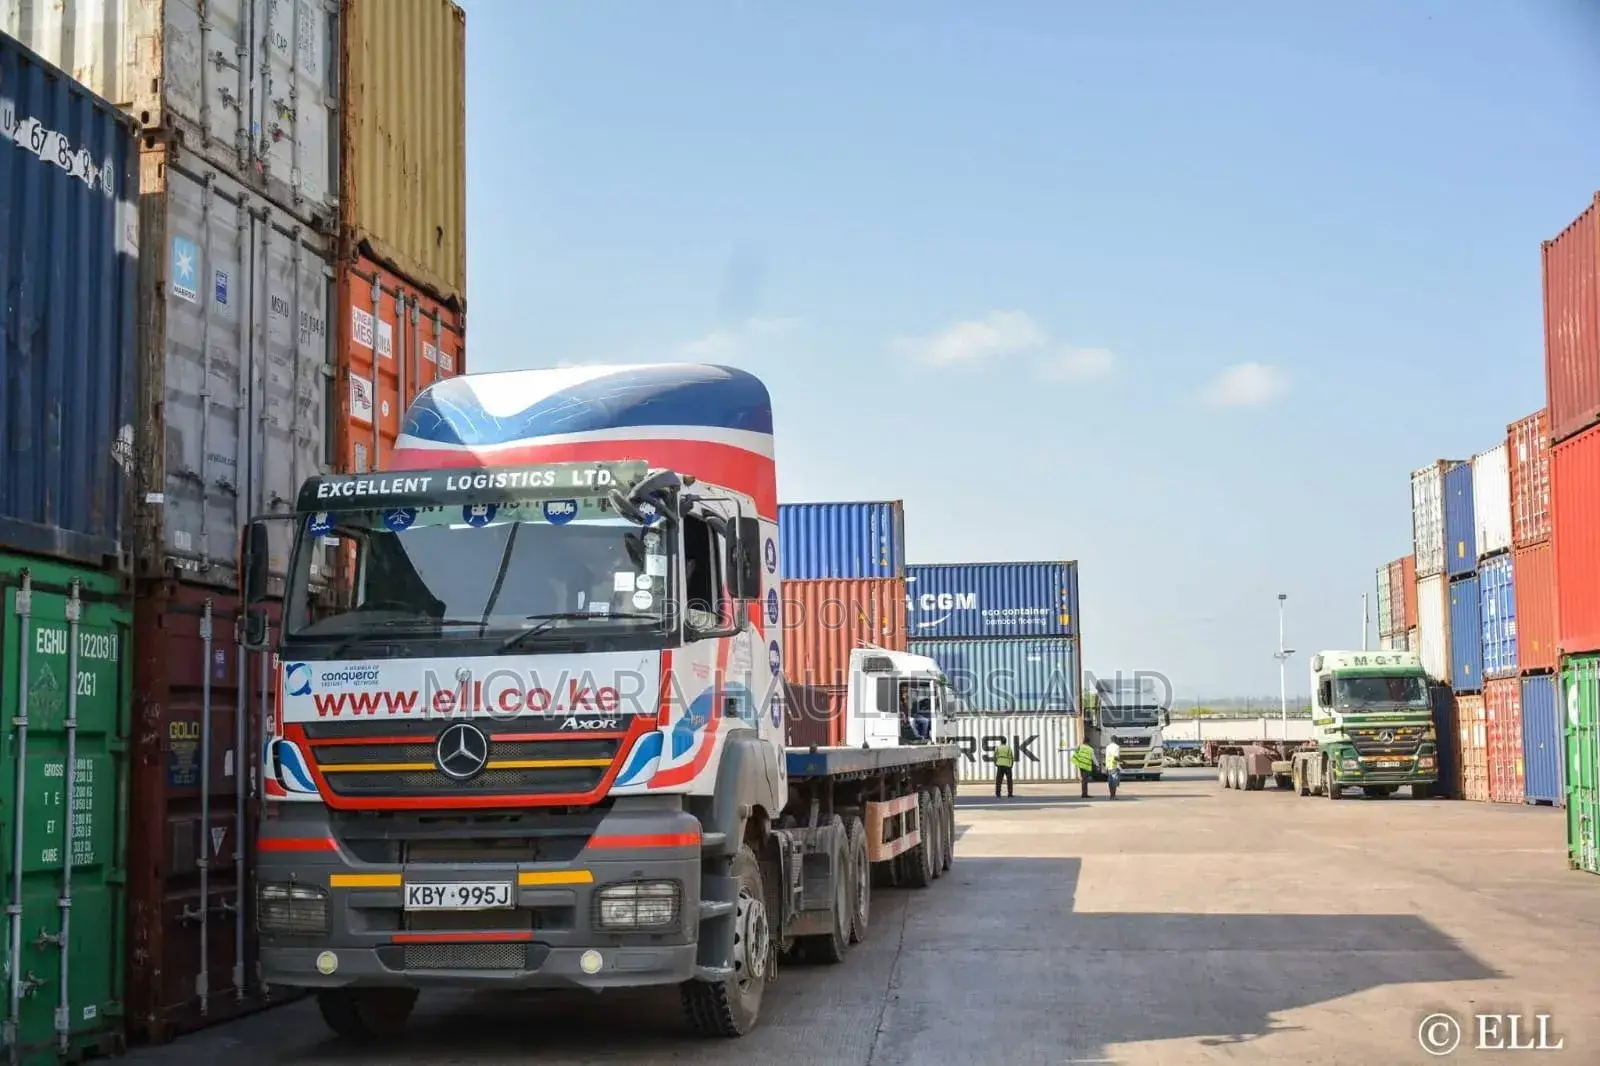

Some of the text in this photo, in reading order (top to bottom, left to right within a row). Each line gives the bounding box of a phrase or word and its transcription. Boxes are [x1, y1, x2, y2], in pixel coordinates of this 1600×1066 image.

[317, 476, 432, 499] EXCELLENT
[447, 471, 556, 491] LOGISTICS
[920, 593, 977, 611] CGM
[982, 606, 1050, 617] eco container
[36, 628, 67, 654] EGHU
[321, 671, 380, 683] conqueror
[313, 678, 620, 717] www.ell.co.ke
[44, 763, 64, 777] GROSS
[42, 848, 58, 862] CUBE
